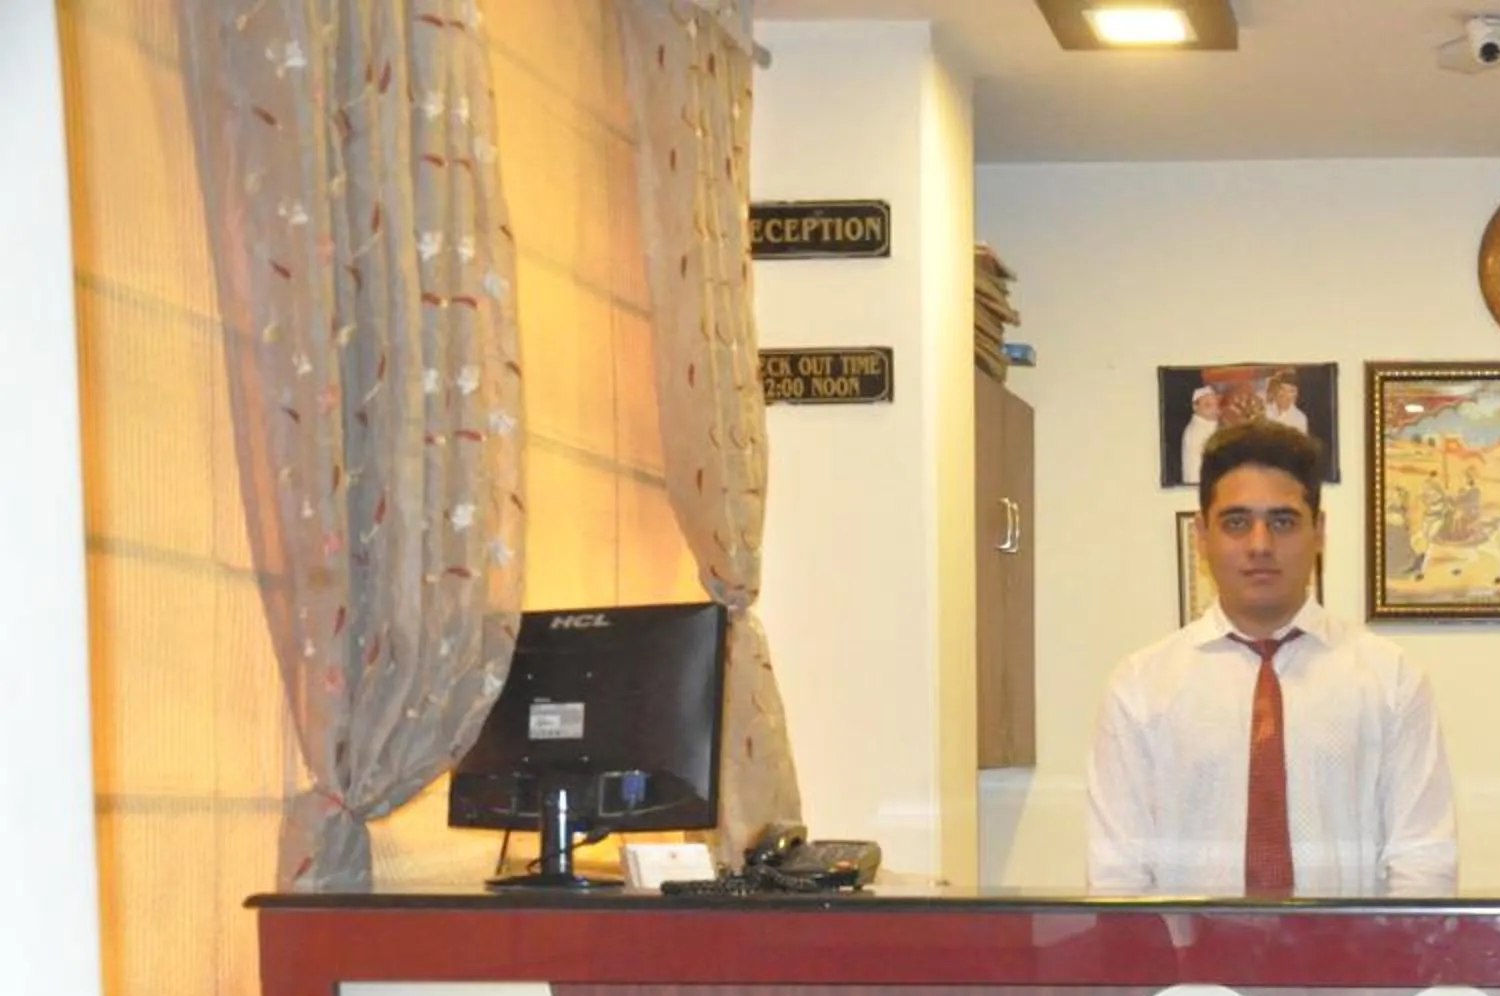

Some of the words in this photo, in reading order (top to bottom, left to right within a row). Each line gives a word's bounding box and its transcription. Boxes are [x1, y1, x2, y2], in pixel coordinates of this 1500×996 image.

[750, 216, 881, 243] ECEPTION
[799, 356, 833, 376] OUT
[840, 354, 881, 375] TIME
[764, 377, 804, 397] 2:00
[811, 376, 860, 397] NOON
[550, 613, 609, 629] HCL
